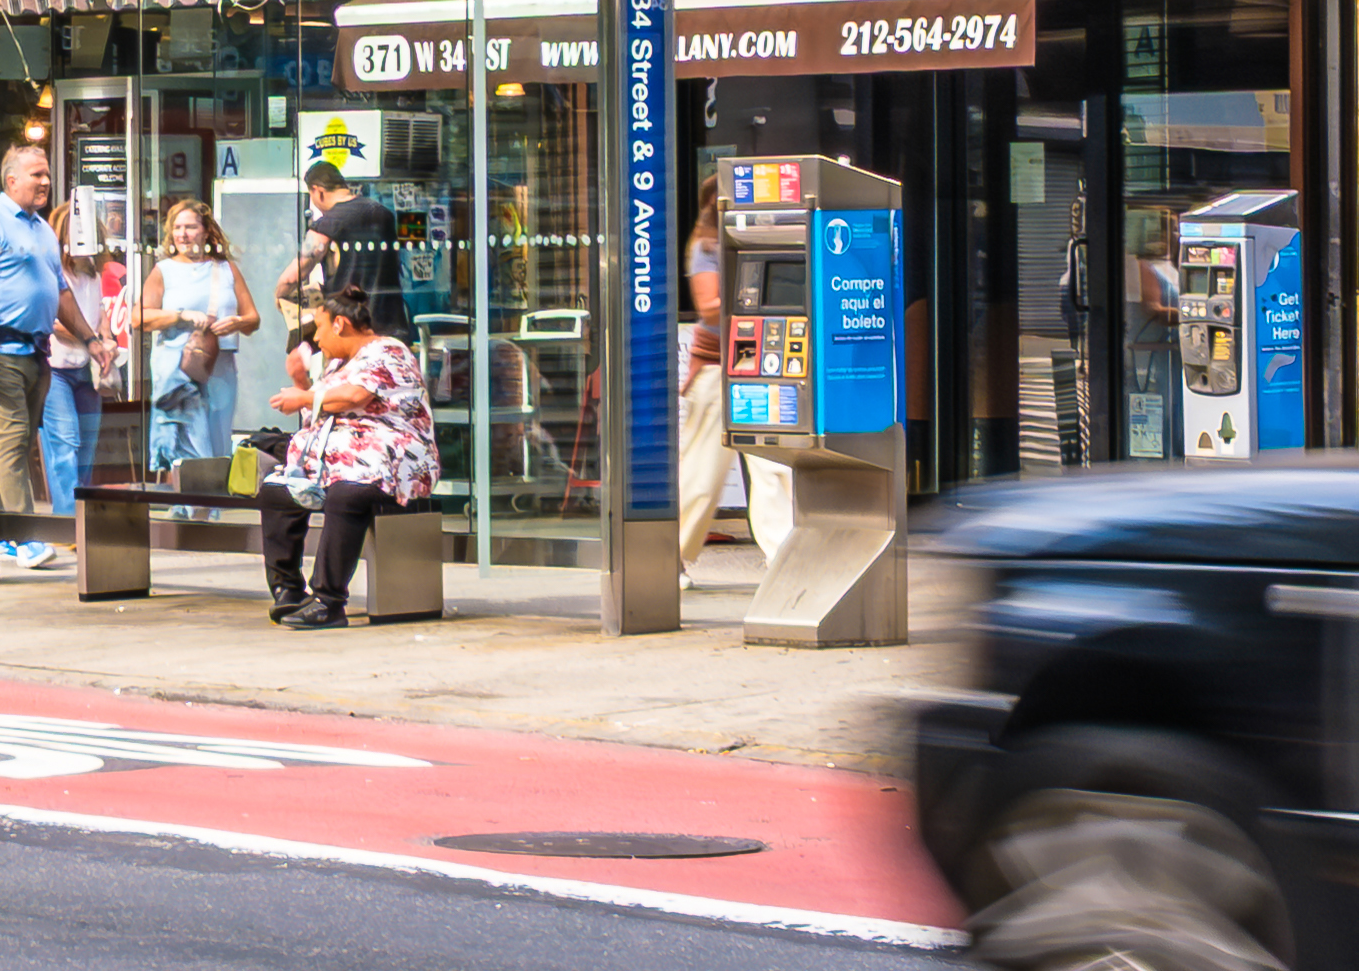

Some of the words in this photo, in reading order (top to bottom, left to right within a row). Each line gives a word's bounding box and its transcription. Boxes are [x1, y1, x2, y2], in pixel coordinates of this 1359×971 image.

[841, 14, 1018, 56] 212-564-2974
[362, 43, 403, 74] 371
[414, 40, 434, 72] W
[439, 36, 474, 72] 34
[485, 38, 512, 71] ST
[631, 39, 653, 132] Street
[222, 145, 239, 176] A
[632, 140, 654, 163] &
[633, 171, 654, 191] 9
[633, 198, 654, 313] Avenue
[831, 276, 885, 292] Compre
[873, 295, 885, 310] el
[1278, 293, 1300, 306] Get
[842, 315, 886, 330] boleto
[1265, 310, 1300, 324] Ticket
[1272, 327, 1301, 341] Here
